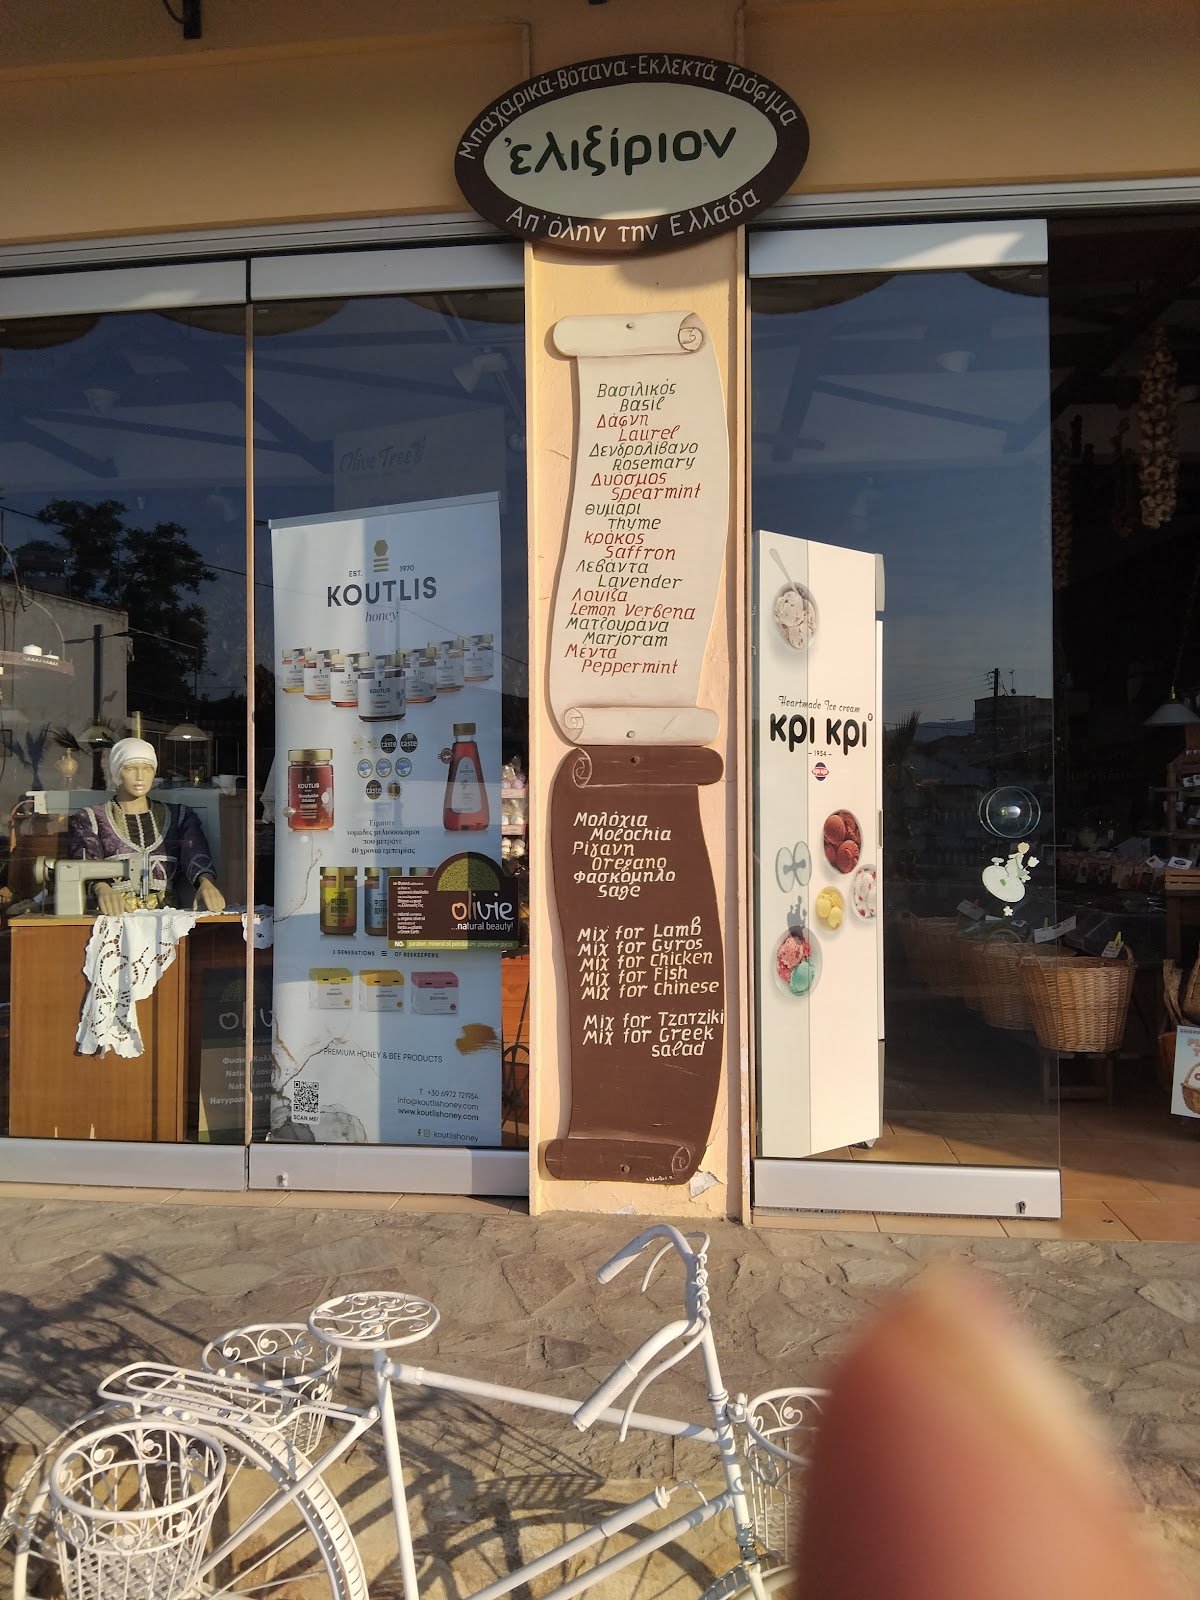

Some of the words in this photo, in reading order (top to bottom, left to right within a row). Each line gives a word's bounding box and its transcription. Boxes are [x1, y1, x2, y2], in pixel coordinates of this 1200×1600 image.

[725, 65, 797, 126] Τρόφιμα
[618, 223, 659, 243] την
[596, 378, 677, 398] Βασιλικός
[619, 396, 665, 413] Basil
[596, 413, 649, 429] Δάφνη
[618, 425, 681, 442] Laurel
[589, 441, 699, 459] Δενδρολίβανο
[612, 457, 696, 472] Rosemary
[591, 471, 668, 487] Δυόσμος
[611, 483, 701, 502] Spearmint
[607, 517, 661, 531] Thyme
[605, 545, 676, 561] Saffron
[575, 559, 649, 574] Λεβάντα
[598, 574, 683, 589] Lavender
[327, 576, 437, 608] KOUTLIS
[365, 611, 399, 623] honey
[570, 602, 616, 617] Lemon
[565, 617, 669, 634] Ματζουράνα
[582, 631, 669, 647] Marjoram
[564, 643, 617, 659] Μέντα
[581, 658, 679, 677] Peppermint
[838, 705, 861, 713] cream
[573, 811, 648, 828] Μολόχια
[589, 827, 672, 842] Molochia
[572, 841, 635, 857] Ρίγανη
[592, 857, 667, 872] Oregano
[573, 868, 676, 885] Φασκόμηλο
[486, 921, 514, 932] beauty!
[577, 926, 609, 943] Mix
[615, 926, 645, 940] for
[653, 916, 702, 938] Lamb
[577, 942, 609, 957] Mix
[617, 941, 647, 955] for
[652, 938, 704, 953] Gyros
[579, 956, 610, 972] Mix
[617, 955, 645, 969] for
[580, 971, 610, 987] Mix
[618, 969, 647, 984] for
[654, 966, 688, 982] Fish
[581, 985, 610, 1000] Mix
[619, 984, 648, 998] for
[583, 1015, 614, 1031] Mix
[623, 1013, 651, 1028] for
[582, 1029, 614, 1045] Mix
[623, 1028, 652, 1044] for
[659, 1026, 714, 1043] Greek
[323, 1048, 356, 1057] PREMIUM
[357, 1050, 381, 1059] HONEY
[388, 1052, 401, 1060] BEE
[402, 1054, 443, 1064] PRODUCTS
[440, 1090, 458, 1098] 6972
[293, 1114, 308, 1122] SCAN
[398, 1108, 479, 1121] www.koutlishoney.com
[433, 1130, 479, 1143] koutlishoney
